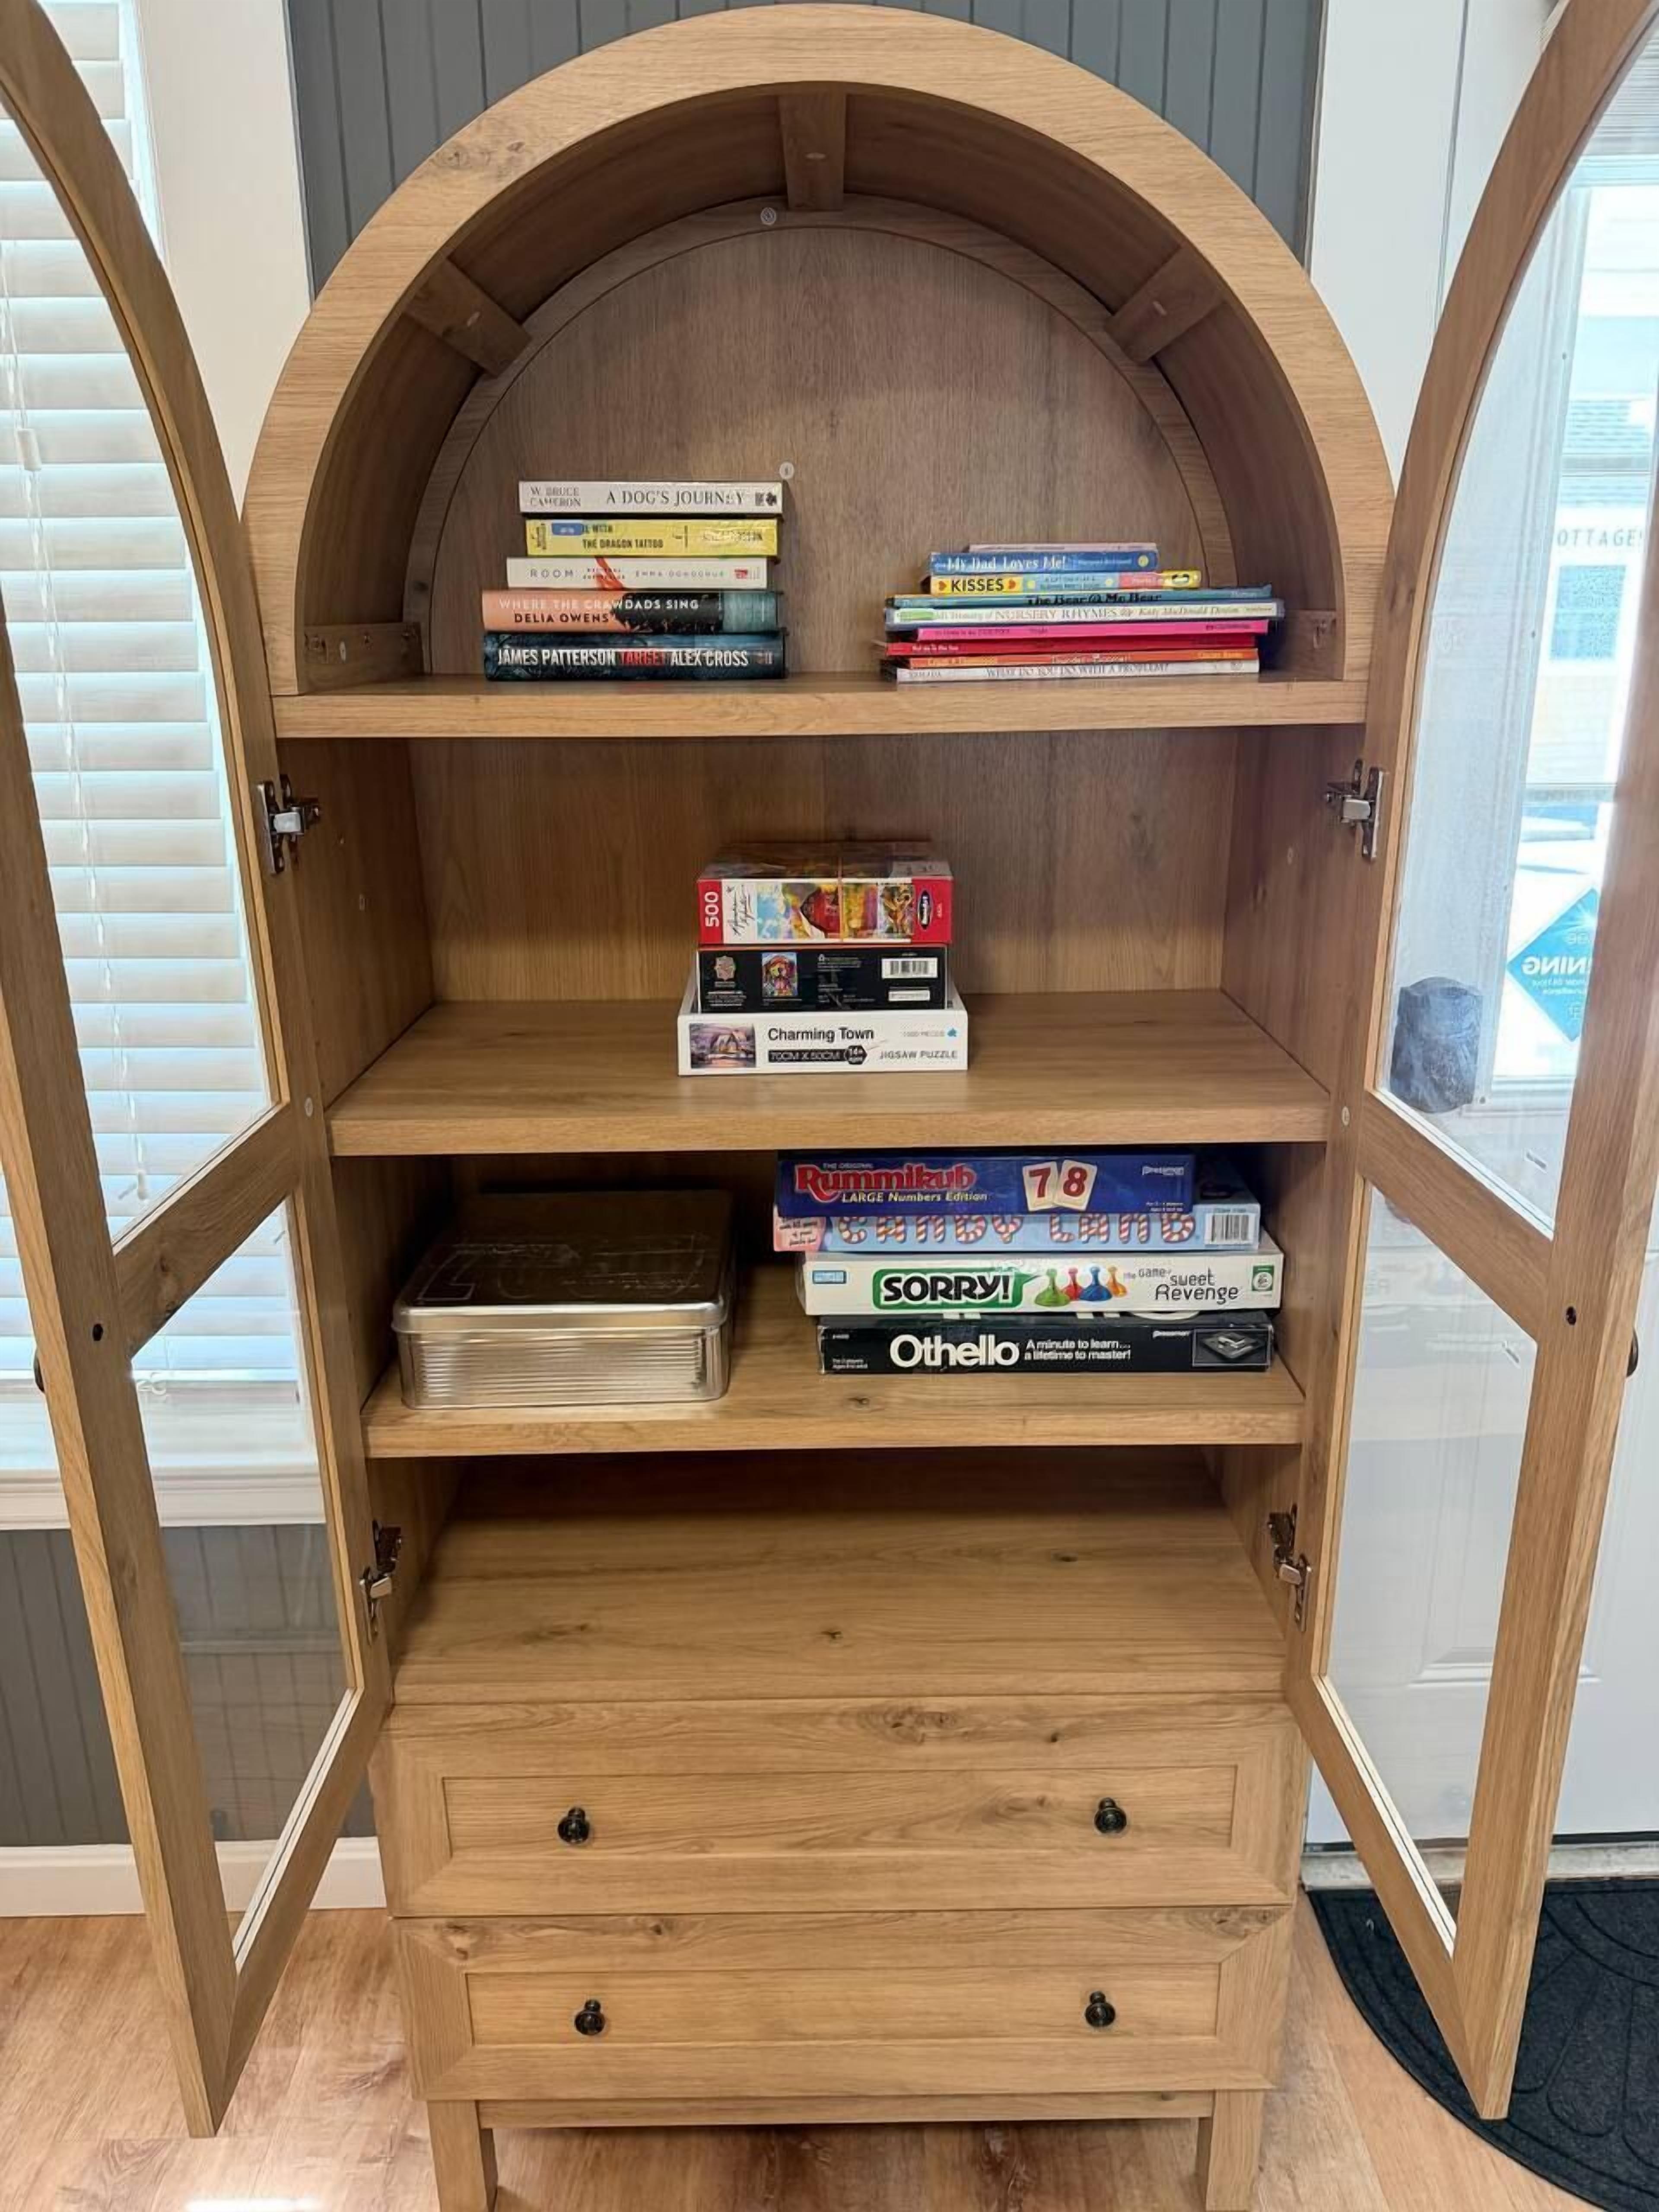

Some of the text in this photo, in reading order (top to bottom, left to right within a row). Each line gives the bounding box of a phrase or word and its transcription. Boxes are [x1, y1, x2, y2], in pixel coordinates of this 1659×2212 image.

[607, 490, 744, 506] A DOG'S JOURNEY
[583, 539, 664, 548] THE DRAGON TATTOO
[1557, 528, 1643, 547] OTTAGE
[947, 557, 965, 571] My
[973, 556, 996, 570] Dad
[1004, 556, 1039, 571] Loves
[1043, 556, 1066, 570] Me!
[530, 569, 574, 578] ROOM
[951, 578, 1004, 592] KISSES
[499, 599, 699, 610] WHERE THE CRAWDADS SING
[1026, 595, 1051, 605] The
[1054, 594, 1087, 605] Bear
[514, 613, 609, 623] DELIA OWENS
[995, 610, 1056, 619] NURSERY
[1062, 607, 1117, 618] RHYMES
[498, 648, 748, 667] JAMES PATTERSON TARGET ALEX CROSS
[704, 891, 720, 927] 500
[768, 1027, 874, 1043] Charming Town
[880, 1050, 958, 1059] JIGSAW PUZZLE
[795, 1163, 978, 1203] Rummikub
[1029, 1167, 1051, 1198] 7
[1063, 1166, 1087, 1197] 8
[842, 1191, 987, 1203] LARGE Numbers Edition
[1138, 1268, 1166, 1278] game
[1170, 1267, 1216, 1286] sweet
[883, 1274, 1010, 1302] SORRY!
[1155, 1284, 1239, 1305] Revenge
[890, 1334, 1020, 1368] Othello
[1026, 1339, 1035, 1349] A
[1037, 1339, 1075, 1349] minute
[1078, 1340, 1089, 1349] to
[1024, 1350, 1131, 1360] a lifetime to master!
